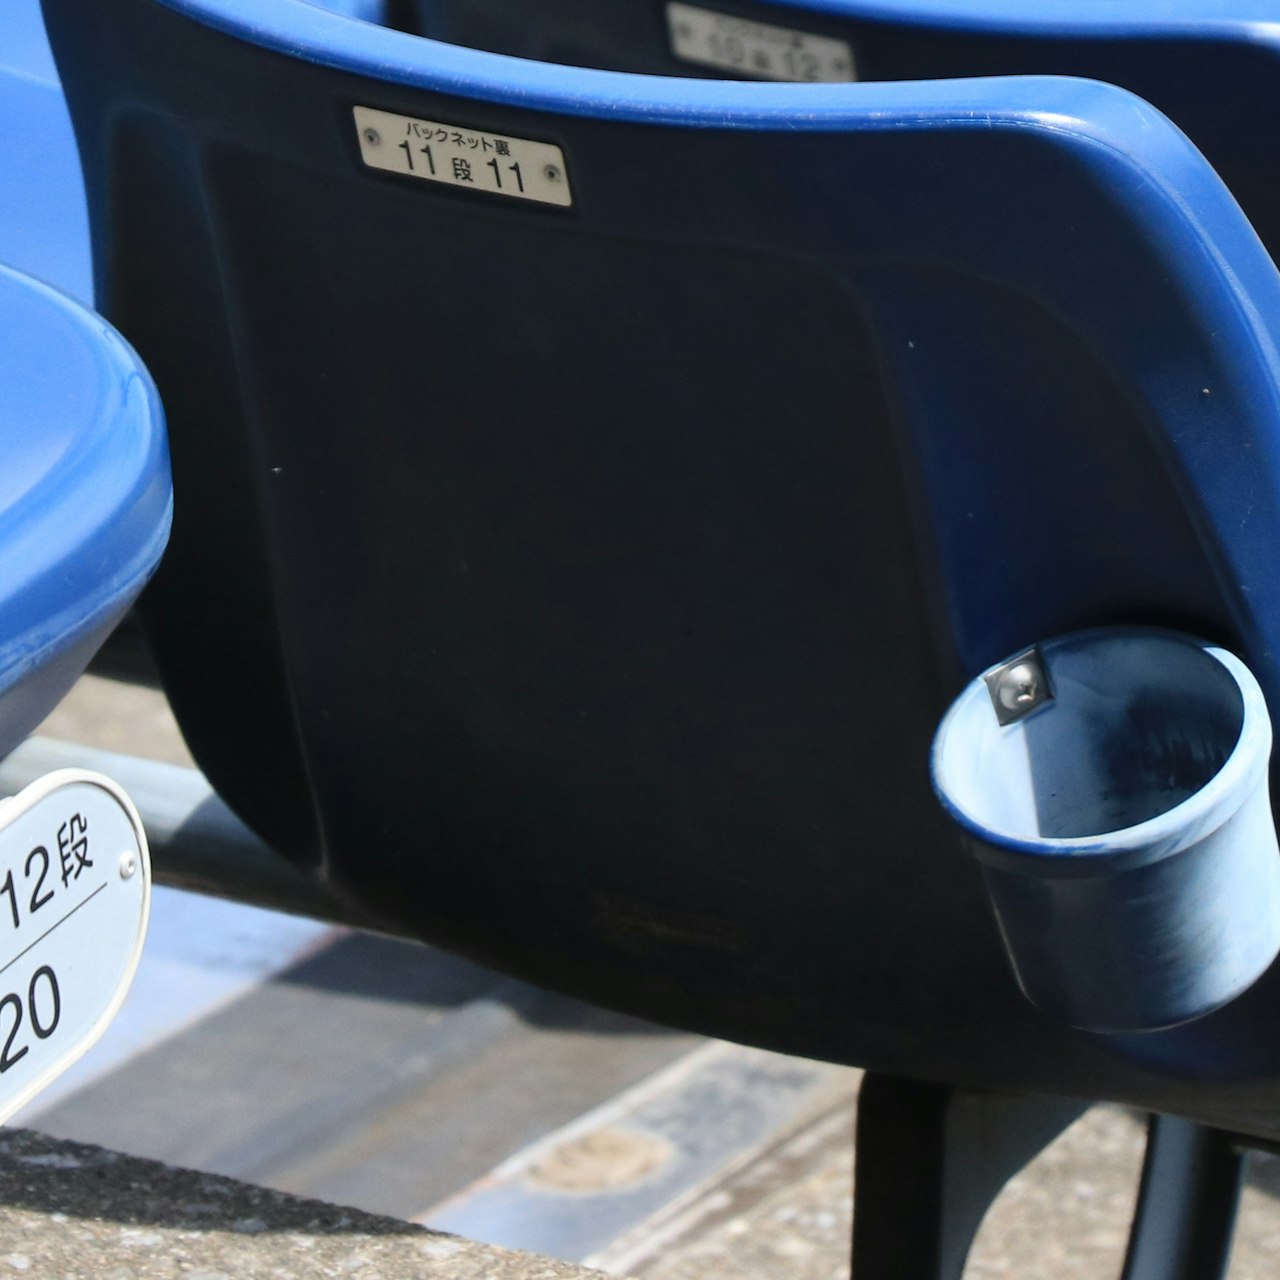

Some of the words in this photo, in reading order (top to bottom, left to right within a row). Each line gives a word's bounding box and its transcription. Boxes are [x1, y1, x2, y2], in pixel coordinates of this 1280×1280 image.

[406, 121, 512, 157] バックネット裏
